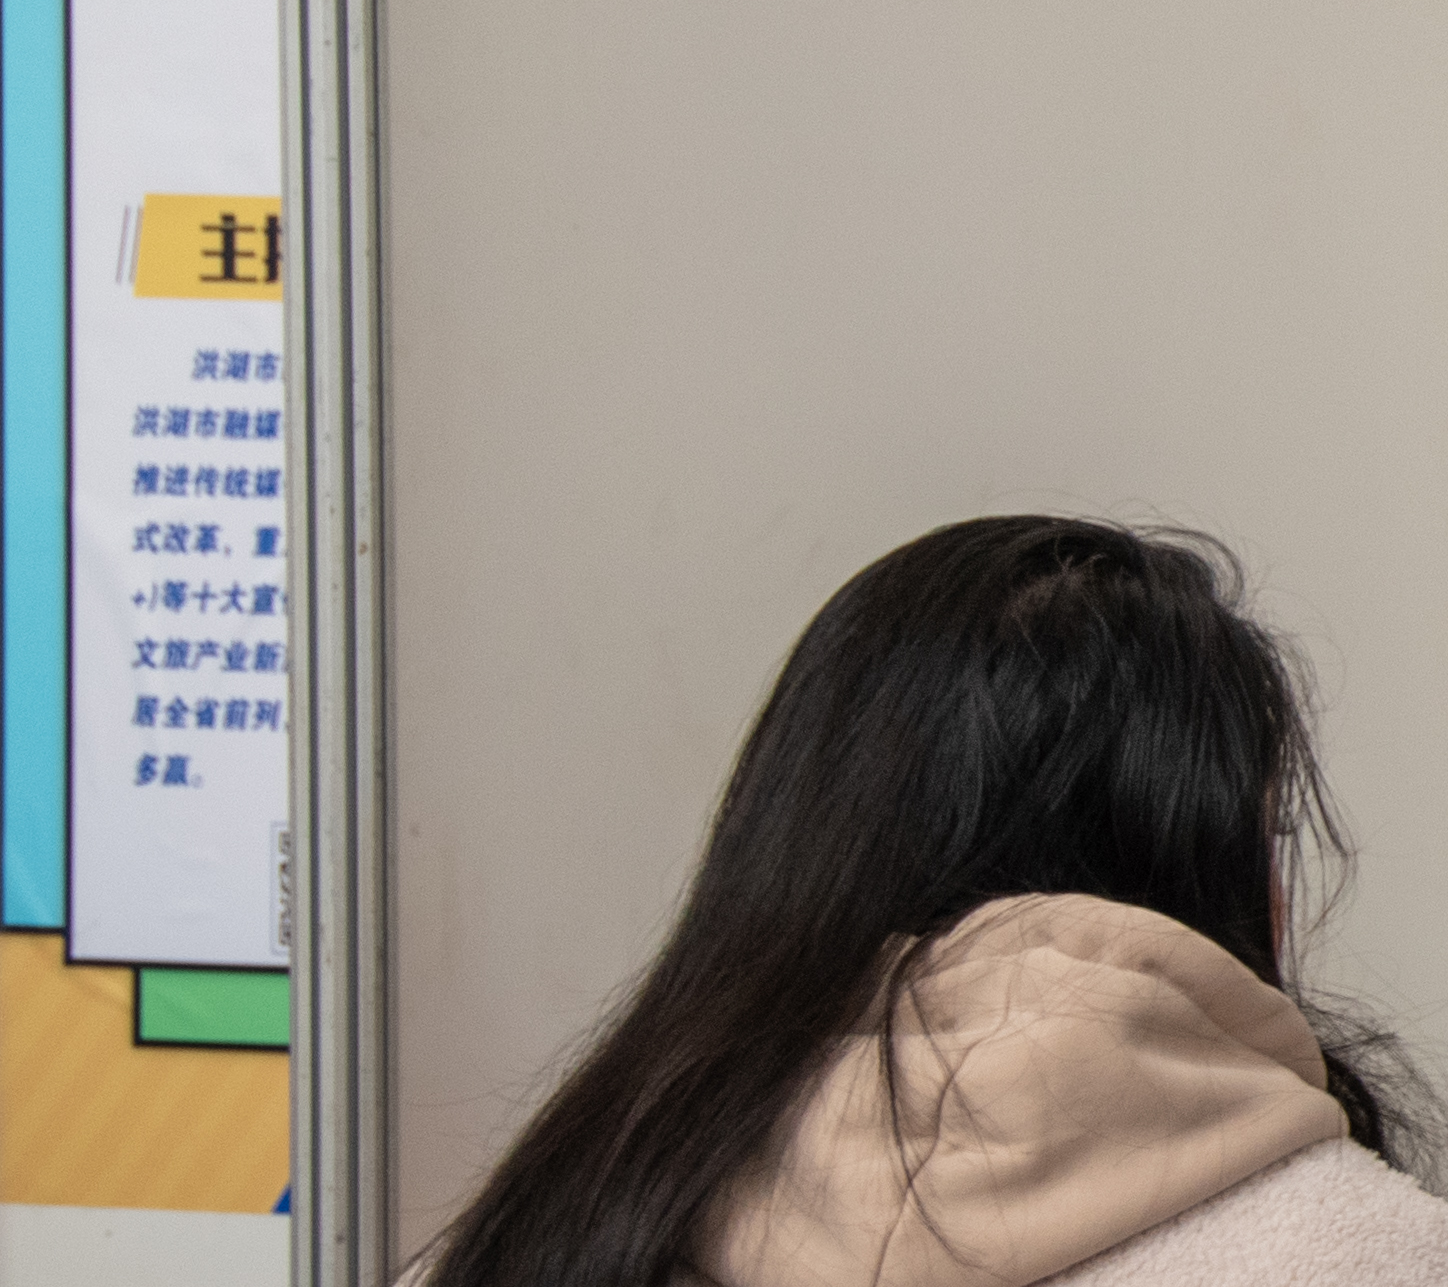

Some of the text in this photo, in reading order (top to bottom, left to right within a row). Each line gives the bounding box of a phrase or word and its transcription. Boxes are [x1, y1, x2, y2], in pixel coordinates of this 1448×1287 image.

[191, 346, 284, 382] 洪湖市
[132, 520, 285, 558] 式改革，重
[131, 635, 287, 673] 文旅产业新
[131, 693, 287, 731] 居全省前列
